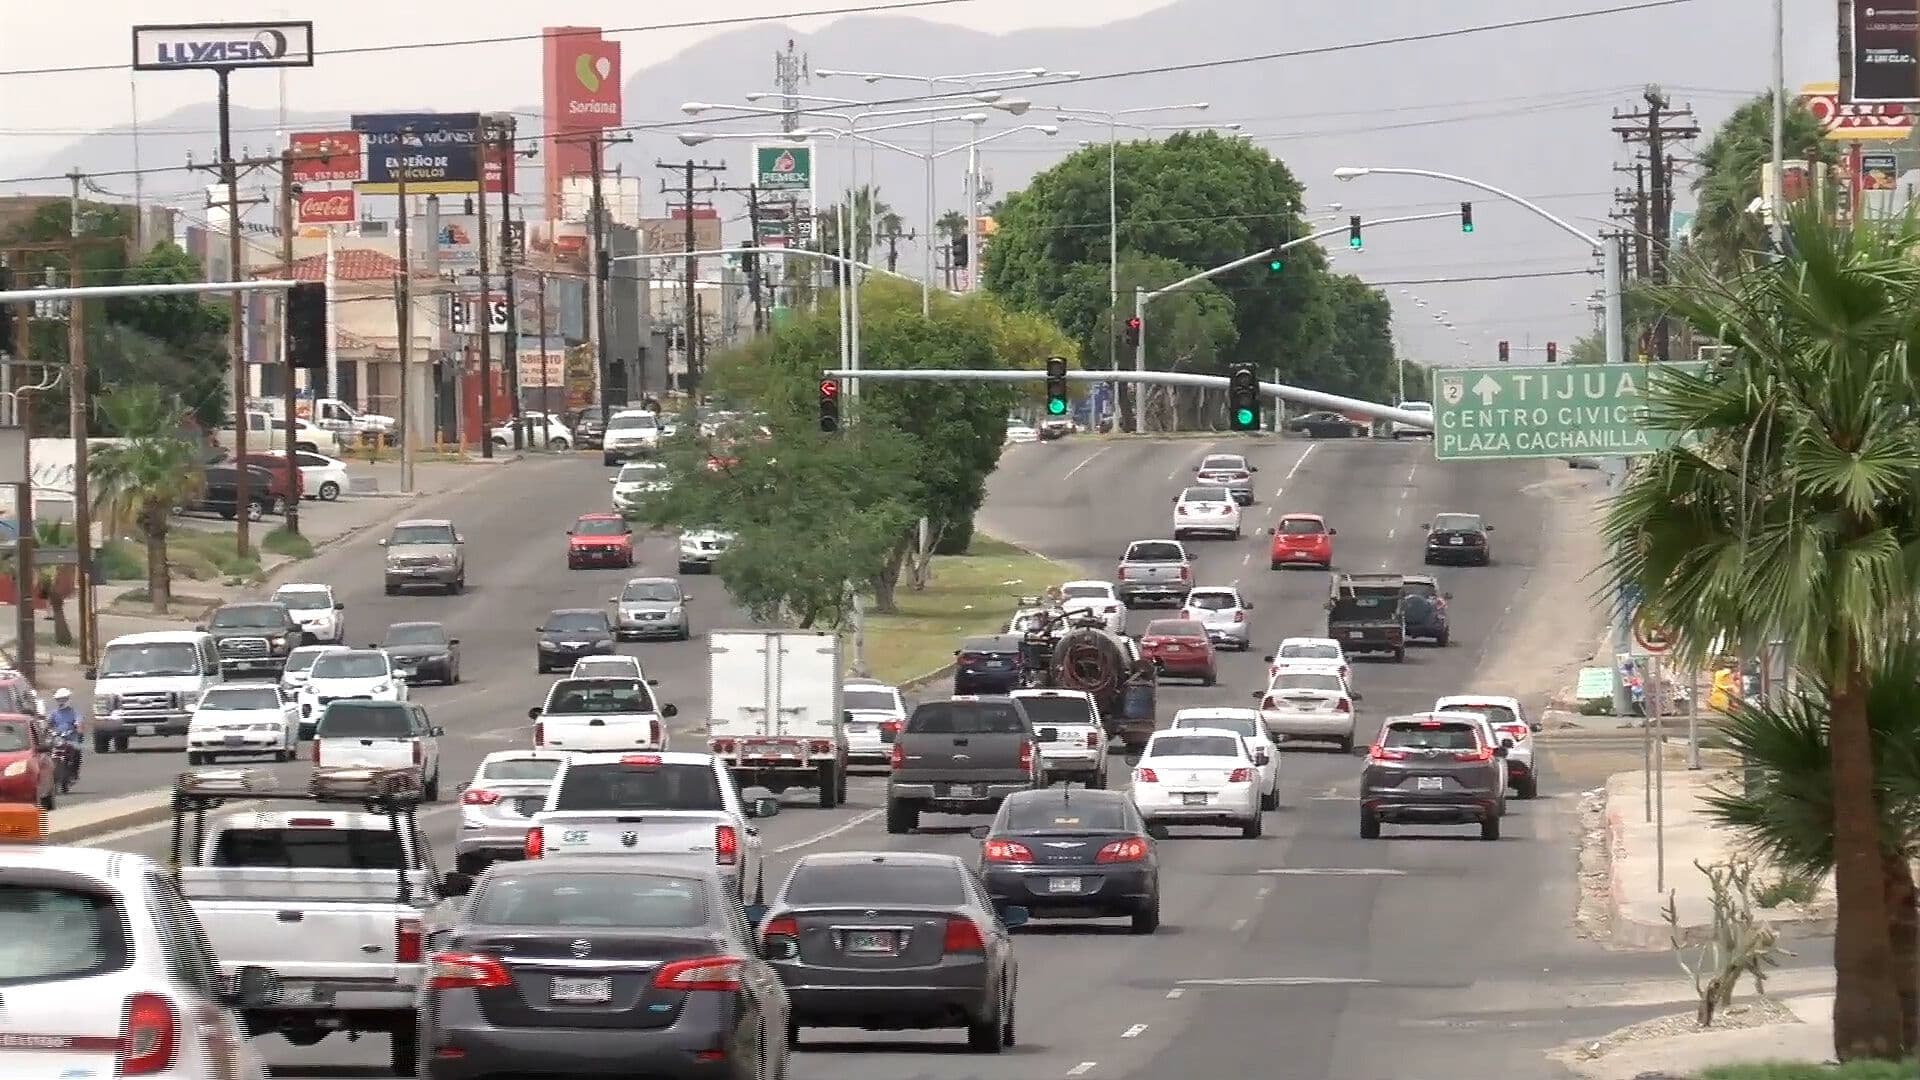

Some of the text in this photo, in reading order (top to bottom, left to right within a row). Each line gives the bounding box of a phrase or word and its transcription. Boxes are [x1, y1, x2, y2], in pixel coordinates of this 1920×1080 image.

[158, 40, 273, 62] LLYASA
[568, 99, 617, 114] Soriana
[434, 156, 448, 167] DE
[762, 172, 808, 183] PEMEX
[1449, 386, 1457, 399] 2
[1442, 405, 1648, 429] CENTRO CIVICO
[1443, 429, 1648, 452] PLAZA CACHANILLA
